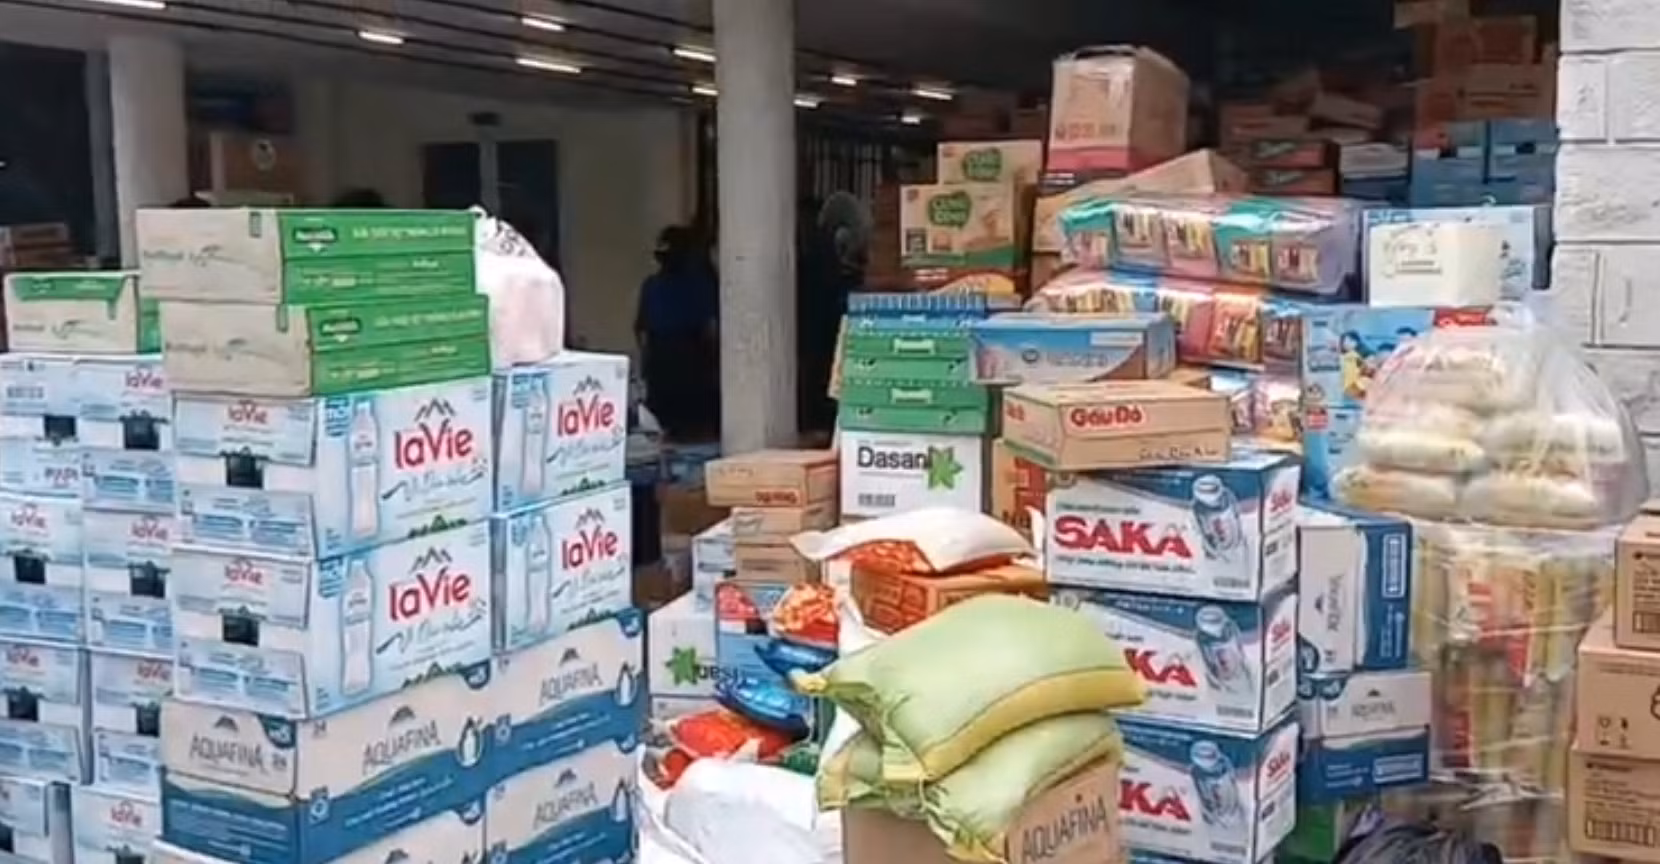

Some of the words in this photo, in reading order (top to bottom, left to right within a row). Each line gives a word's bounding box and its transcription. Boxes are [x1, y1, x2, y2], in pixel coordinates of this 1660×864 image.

[125, 368, 163, 388] laVie
[228, 404, 267, 424] laVie
[557, 395, 615, 436] laVie
[394, 418, 473, 470] laVie
[10, 509, 46, 529] laVie
[132, 519, 170, 540] laVie
[1055, 515, 1193, 558] SAKA
[562, 525, 618, 569] laVie
[225, 564, 263, 585] laVie
[388, 566, 471, 621] laVie
[539, 664, 603, 704] AQUAFINA
[1124, 648, 1197, 687] KA
[188, 732, 269, 775] AQUAFINA
[363, 721, 442, 772] AQUAFINA
[533, 783, 598, 829] AQUAFINA
[1119, 779, 1192, 821] KA
[1021, 796, 1109, 859] AQUAFINA
